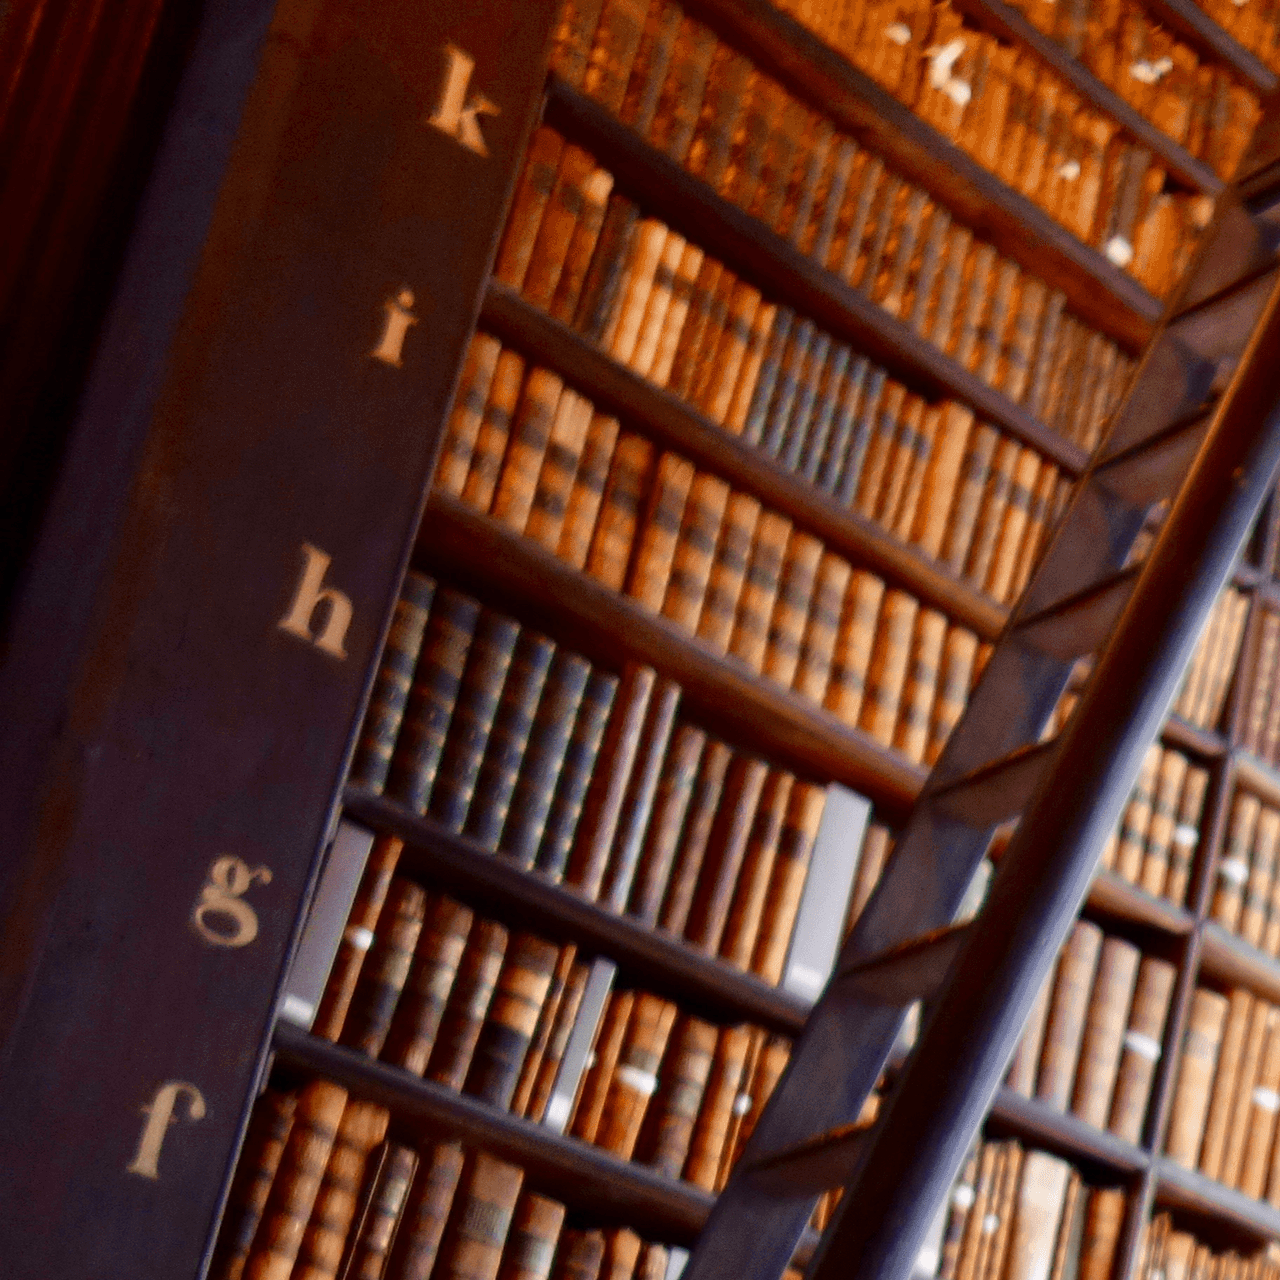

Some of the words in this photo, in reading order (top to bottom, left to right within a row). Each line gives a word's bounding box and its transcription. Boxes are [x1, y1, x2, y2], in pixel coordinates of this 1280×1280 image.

[428, 44, 499, 156] k
[371, 288, 418, 368] i
[278, 544, 353, 659] h
[192, 855, 272, 948] g
[127, 1080, 206, 1180] f
